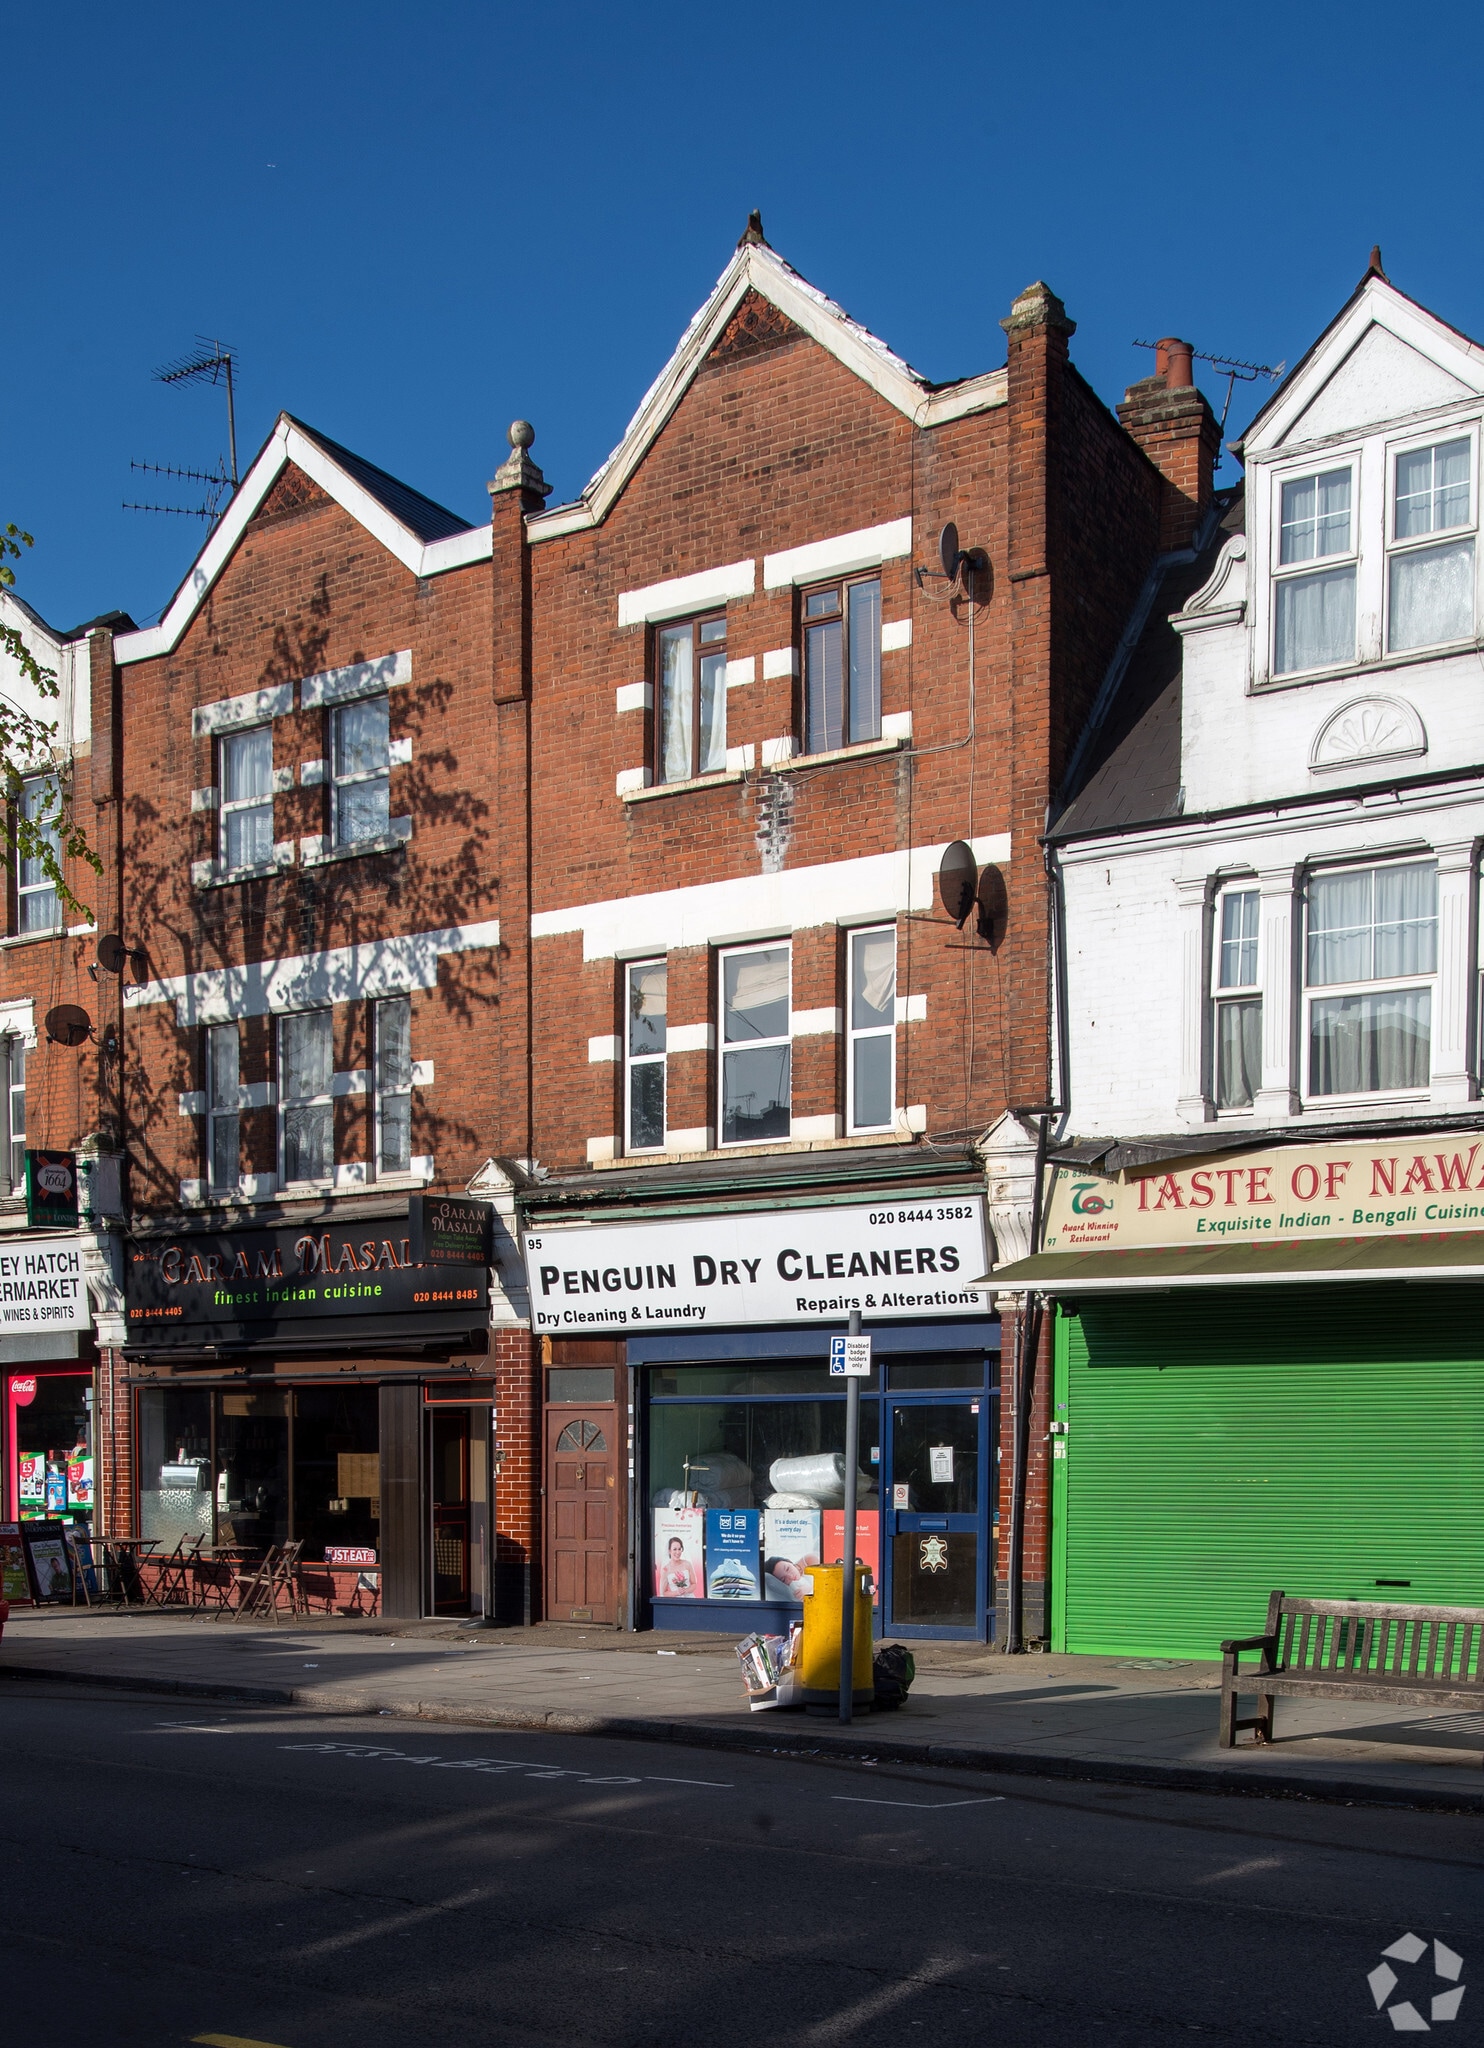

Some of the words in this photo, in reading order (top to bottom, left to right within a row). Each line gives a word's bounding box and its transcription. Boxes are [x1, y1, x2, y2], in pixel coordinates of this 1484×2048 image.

[45, 1174, 66, 1188] 1664
[1054, 1169, 1068, 1180] 020
[1130, 1166, 1276, 1213] TASTE
[1291, 1160, 1354, 1203] OF
[1368, 1142, 1484, 1198] NAW
[440, 1203, 486, 1221] GARAM
[869, 1212, 895, 1225] 020
[898, 1209, 933, 1223] 8444
[937, 1206, 973, 1220] 3582
[432, 1216, 483, 1234] MASALA
[1062, 1223, 1086, 1233] Award
[1088, 1221, 1119, 1231] Winning
[1197, 1216, 1272, 1235] Exquisite
[1279, 1212, 1331, 1229] Indian
[1352, 1206, 1417, 1227] Bengali
[528, 1239, 542, 1250] 95
[1047, 1237, 1056, 1246] 97
[1069, 1233, 1111, 1243] Restaurant
[159, 1246, 283, 1285] GARAM
[294, 1233, 438, 1275] MASAL
[430, 1249, 444, 1258] 020
[447, 1250, 464, 1259] 8444
[25, 1251, 79, 1275] HATCH
[540, 1264, 677, 1295] PENGUIN
[692, 1255, 762, 1287] DRY
[777, 1246, 960, 1282] CLEANERS
[214, 1290, 258, 1305] finest
[266, 1286, 316, 1302] indian
[324, 1283, 383, 1300] cuisine
[413, 1292, 429, 1302] 020
[432, 1291, 453, 1301] 8444
[456, 1289, 478, 1300] 8485
[796, 1296, 860, 1314] Repairs
[865, 1294, 877, 1307] &
[881, 1290, 979, 1308] Alterations
[3, 1307, 31, 1321] WINES
[33, 1307, 39, 1320] &
[40, 1305, 75, 1320] SPIRITS
[130, 1308, 143, 1318] 020
[145, 1307, 163, 1317] 8444
[164, 1306, 183, 1316] 4405
[537, 1311, 560, 1327] Dry
[563, 1308, 627, 1323] Cleaning
[631, 1306, 642, 1319] &
[645, 1304, 706, 1319] Laundry
[834, 1340, 843, 1353] P
[22, 1462, 32, 1473] £5
[350, 1549, 368, 1561] EAT
